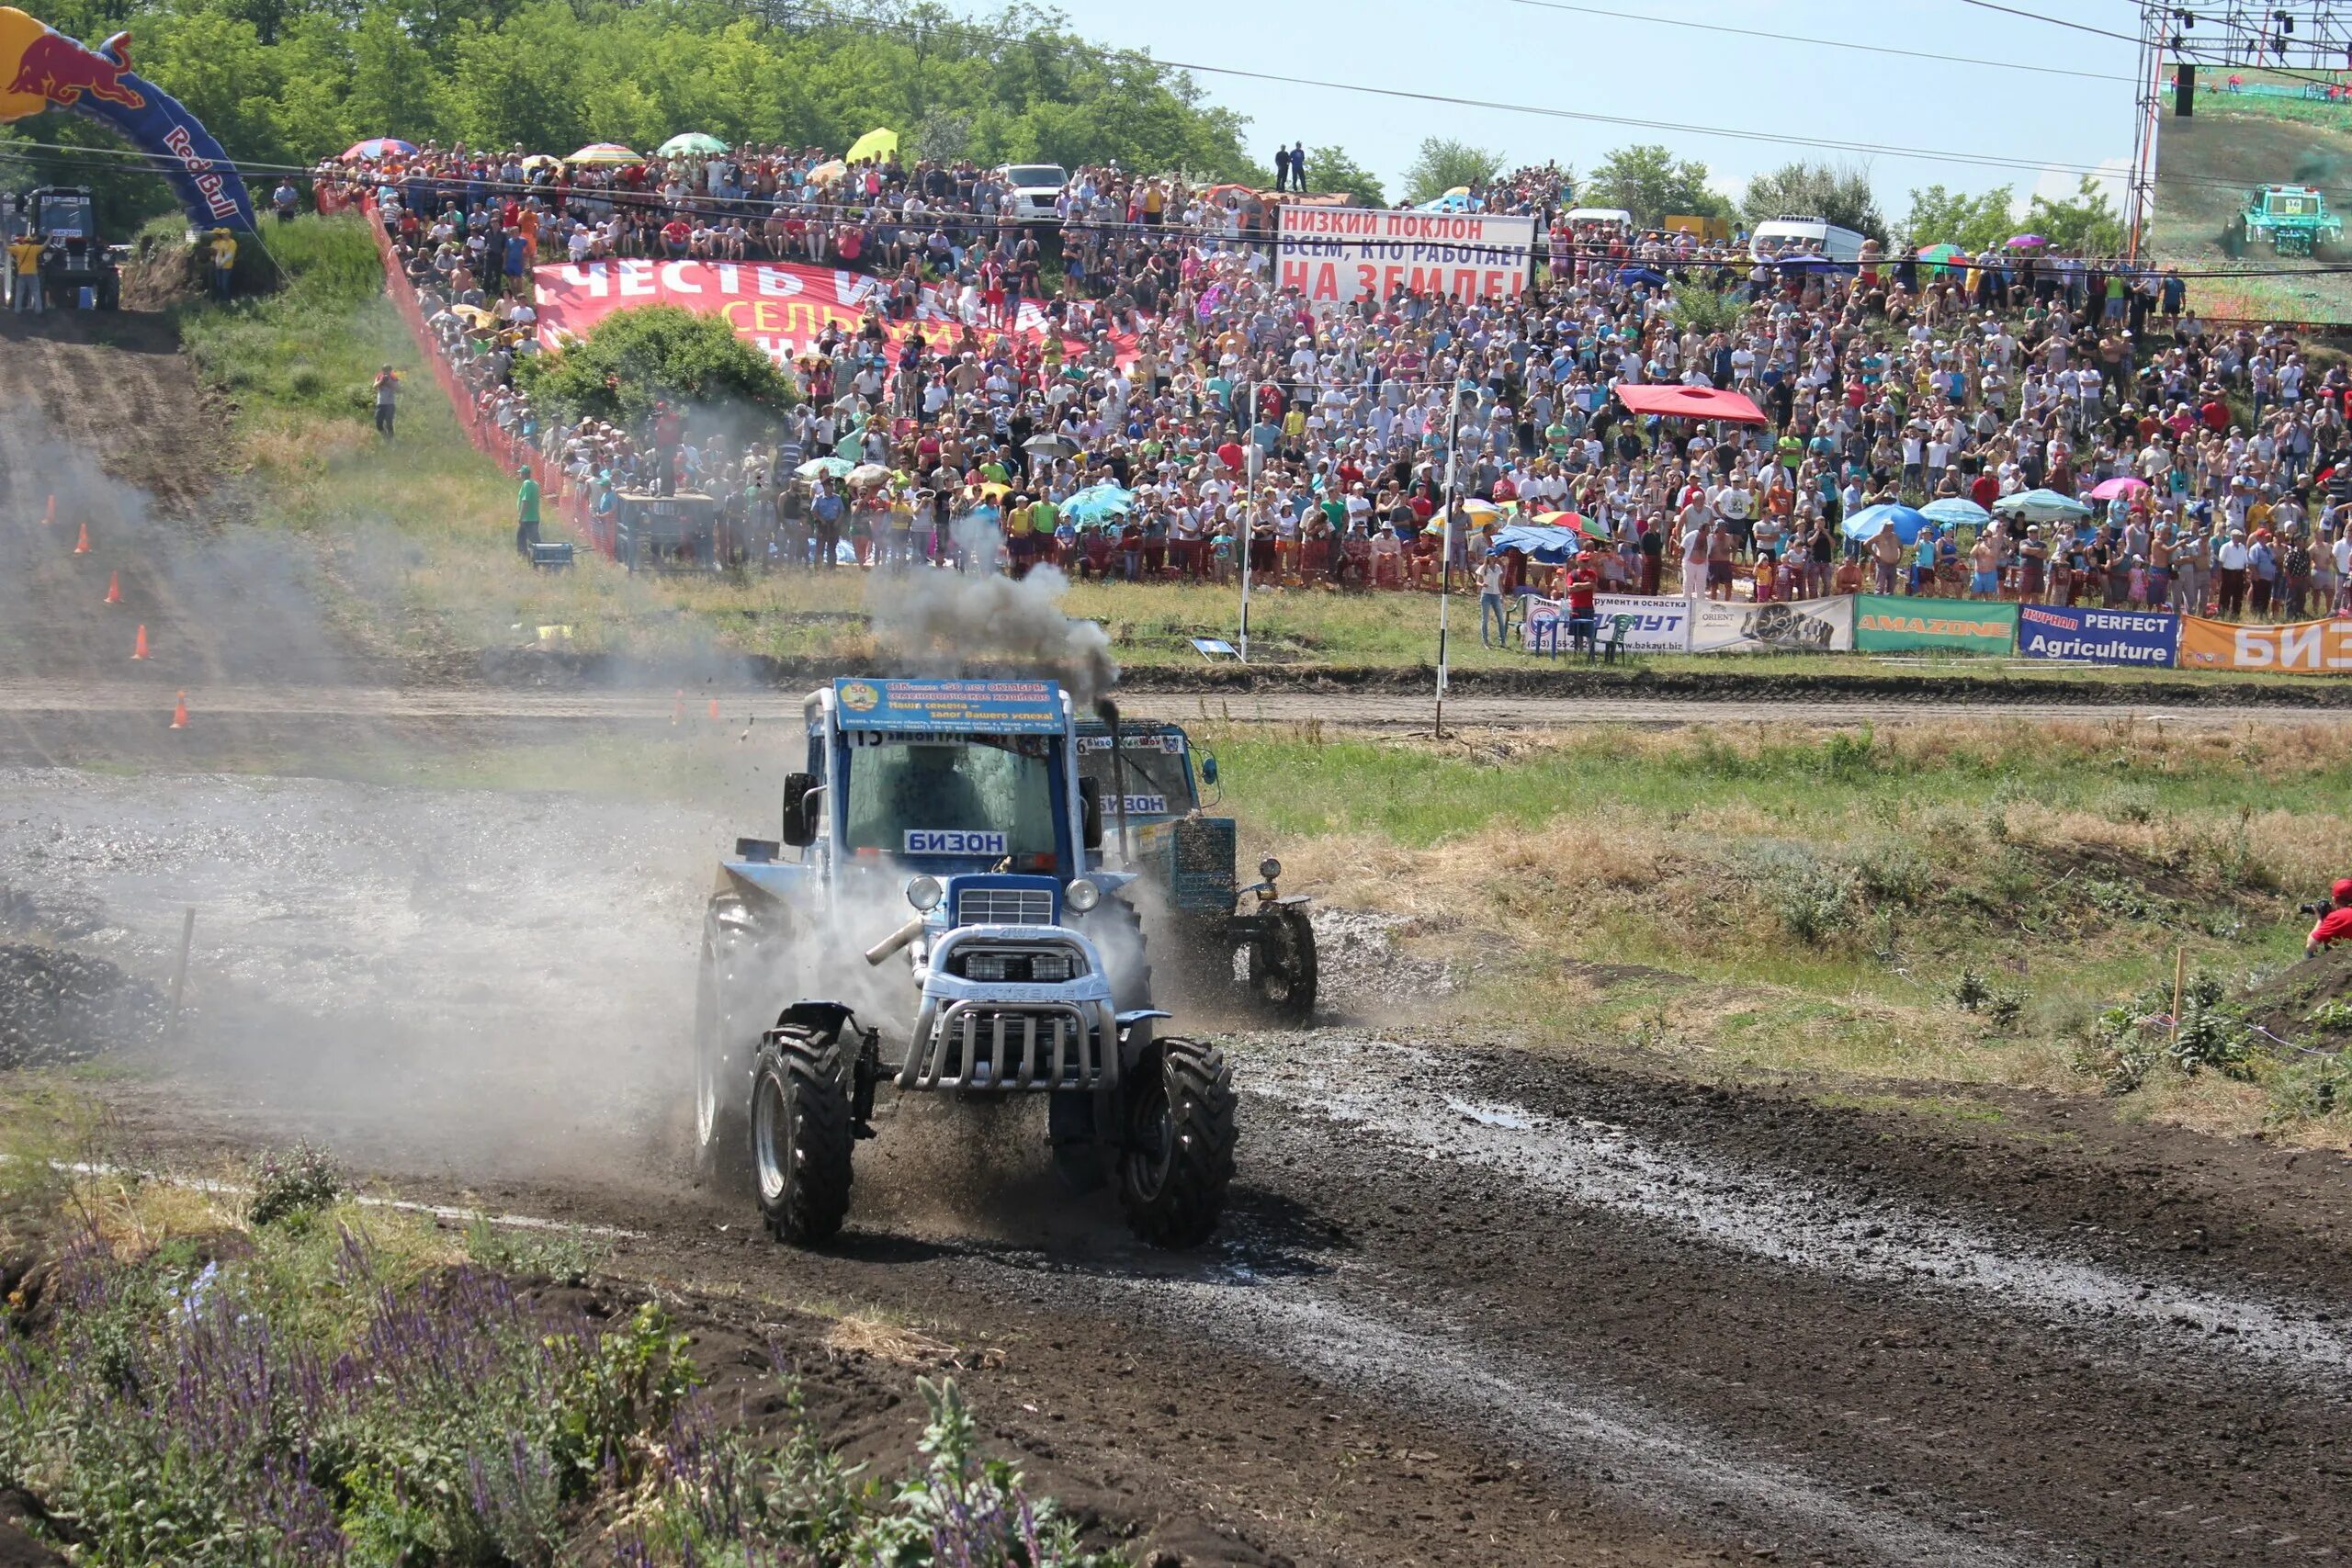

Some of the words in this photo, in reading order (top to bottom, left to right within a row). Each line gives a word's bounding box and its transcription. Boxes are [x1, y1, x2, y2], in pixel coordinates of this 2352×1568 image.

[163, 125, 212, 177] Red
[195, 174, 239, 220] Bull
[1283, 209, 1378, 235] НИЗКИЙ
[1386, 216, 1484, 240] ПОКЛОН
[1283, 234, 1351, 261] ВСЕМ,
[1361, 239, 1404, 261] КТО
[1413, 242, 1527, 266] РАБОТАЕТ
[561, 259, 804, 297] ЧЕСТЬ
[1282, 260, 1339, 301] НА
[1702, 613, 1735, 621] ORIENT
[1857, 615, 2012, 638] AMAZONE
[2022, 608, 2078, 631] ЖУРНАЛ
[2085, 614, 2169, 633] PERFECT
[2029, 635, 2167, 661] Agriculture
[925, 702, 967, 710] семена
[930, 711, 961, 719] залог
[966, 711, 1009, 720] Вашего
[1012, 712, 1054, 721] успеха!
[909, 833, 1003, 852] БИЗОН
[999, 927, 1038, 938] 4WD
[966, 987, 1077, 999] EXTREME
